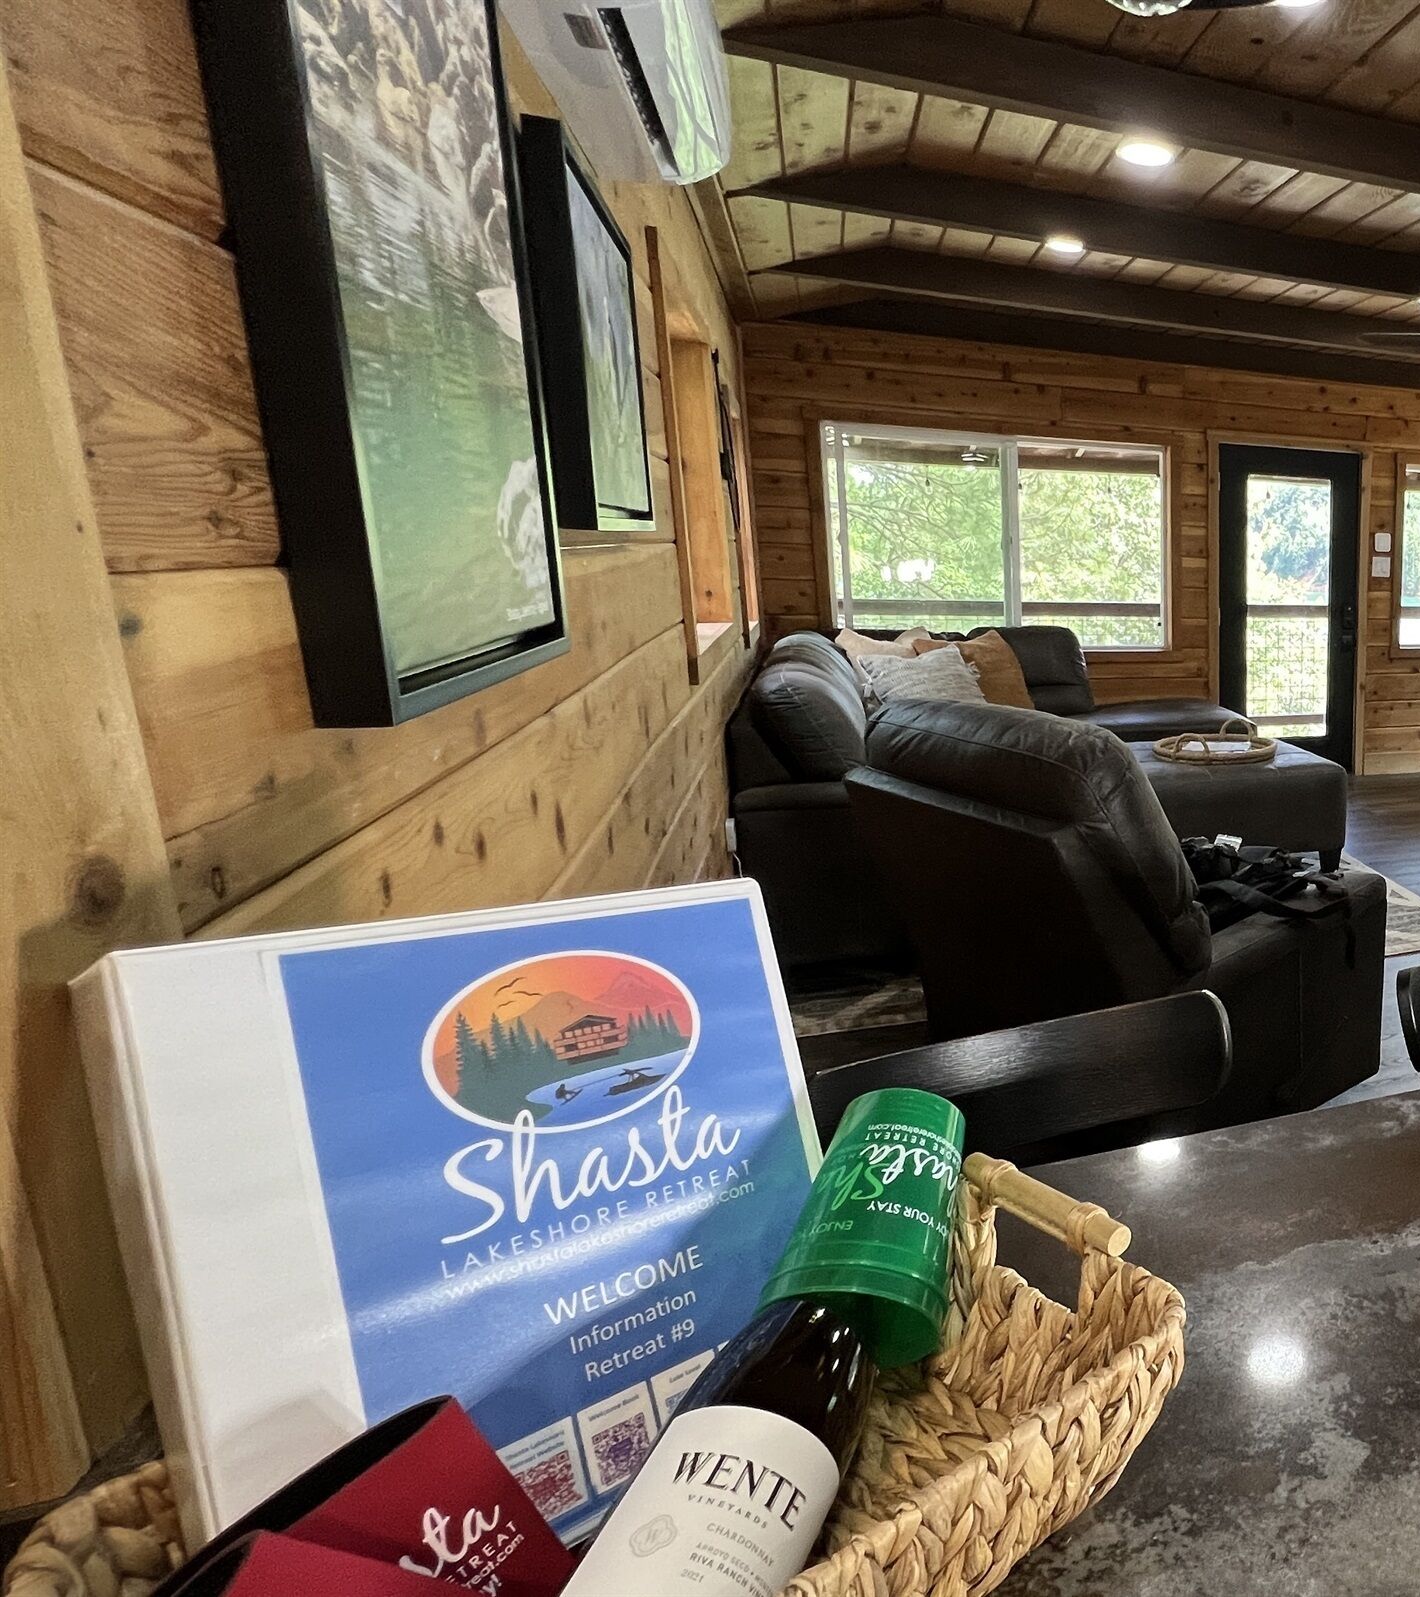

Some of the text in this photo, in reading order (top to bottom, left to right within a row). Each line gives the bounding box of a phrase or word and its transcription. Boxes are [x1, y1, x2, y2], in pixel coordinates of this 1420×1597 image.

[441, 1085, 741, 1244] Shasta
[864, 1132, 926, 1147] RETREAT
[441, 1159, 750, 1279] LAKESHORE RETREAT
[866, 1200, 902, 1215] STAY
[903, 1206, 936, 1228] YOUR
[544, 1245, 703, 1325] WELCOME
[570, 1290, 697, 1355] Information
[584, 1318, 696, 1382] Retreat #9
[672, 1451, 808, 1532] WENTE
[687, 1494, 768, 1529] VINEYARDS
[690, 1552, 714, 1569] RIVA
[716, 1562, 748, 1588] RANCH
[706, 1522, 774, 1567] CHARDONNAY
